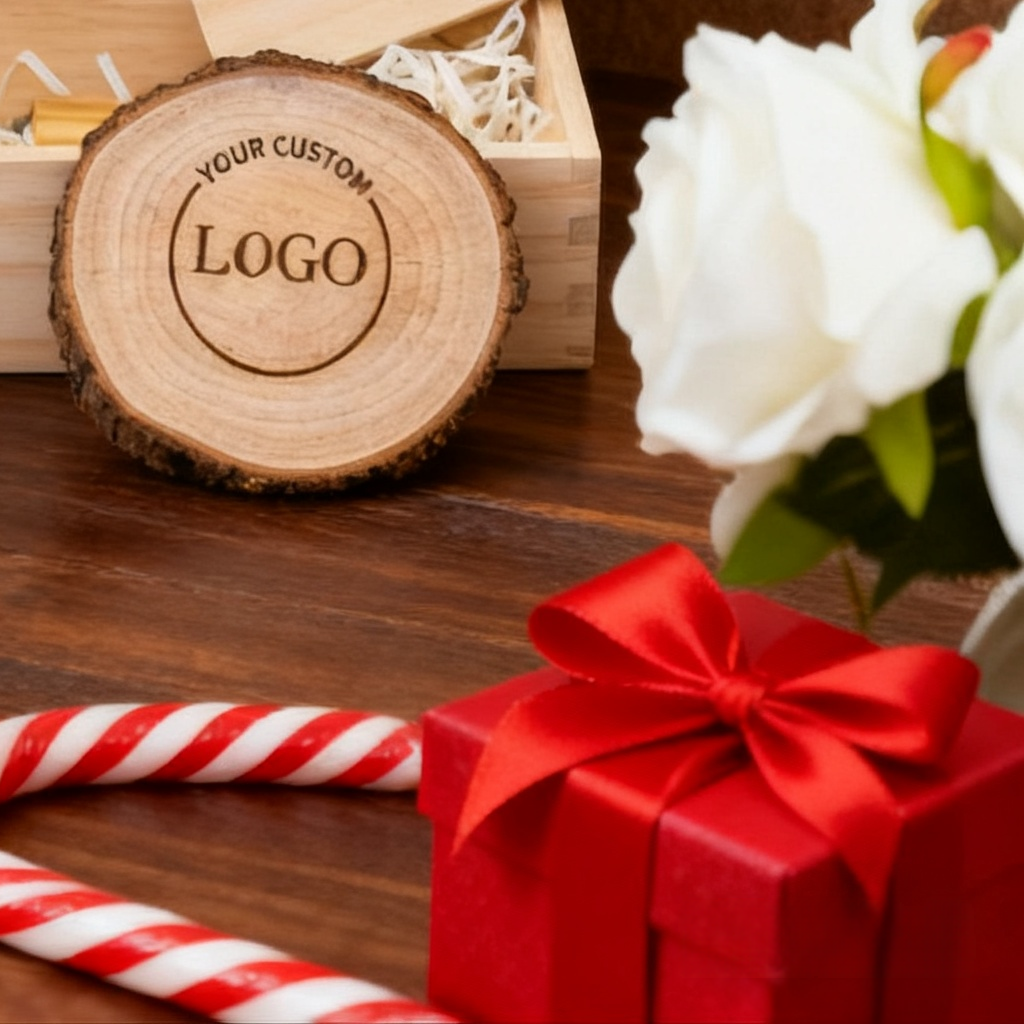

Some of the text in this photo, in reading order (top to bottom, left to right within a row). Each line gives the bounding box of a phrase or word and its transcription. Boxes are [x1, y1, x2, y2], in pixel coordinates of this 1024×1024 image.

[195, 135, 374, 197] YOUR CUSTOM
[193, 223, 369, 288] LOGO
